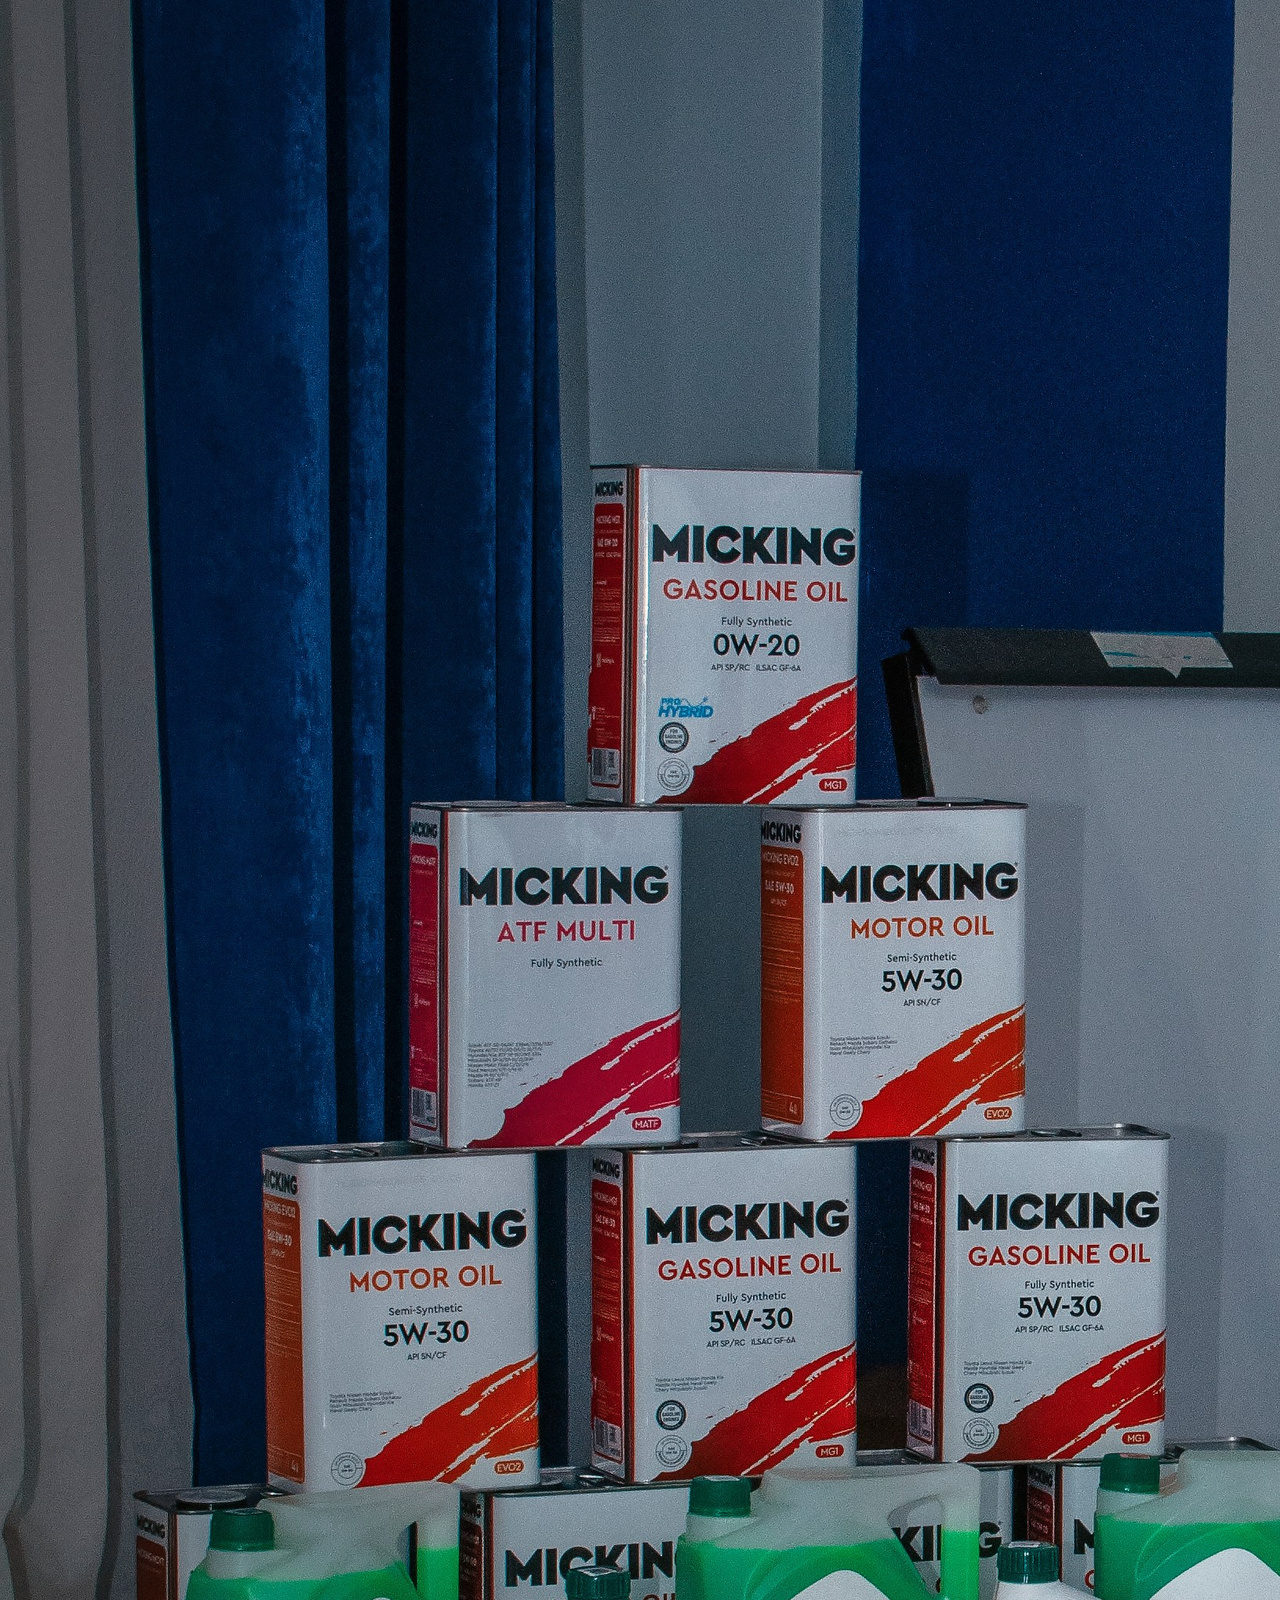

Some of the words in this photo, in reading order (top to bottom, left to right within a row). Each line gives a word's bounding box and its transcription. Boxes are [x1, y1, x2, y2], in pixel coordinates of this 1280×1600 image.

[652, 524, 856, 566] MICKING
[663, 578, 797, 601] GASOLINE
[806, 581, 848, 602] OIL
[721, 616, 744, 628] Fully
[746, 616, 792, 628] Synthetic
[713, 633, 800, 656] 0W-20
[725, 664, 750, 672] SP/RC
[756, 664, 777, 672] ILSAC
[661, 697, 682, 705] PRO
[658, 705, 714, 718] HYBRID
[824, 781, 842, 790] MG1
[459, 865, 669, 906] MICKING
[821, 862, 1018, 903] MICKING
[497, 920, 547, 942] ATF
[556, 920, 636, 941] MULTI
[851, 917, 944, 939] MOTOR
[953, 915, 994, 936] OIL
[531, 958, 553, 969] Fully
[556, 958, 602, 968] Synthetic
[887, 952, 957, 964] Semi-Synthetic
[881, 968, 962, 992] 5W-30
[917, 998, 941, 1006] SN/CF
[986, 1109, 1010, 1118] EVO2
[635, 1119, 659, 1128] MATF
[957, 1191, 1160, 1231] MICKING
[646, 1200, 849, 1245] MICKING
[318, 1209, 527, 1257] MICKING
[968, 1244, 1100, 1266] GASOLINE
[1109, 1243, 1150, 1263] OIL
[658, 1255, 791, 1280] GASOLINE
[800, 1253, 841, 1274] OIL
[350, 1268, 448, 1292] MOTOR
[458, 1264, 502, 1287] OIL
[1025, 1280, 1046, 1291] Fully
[1050, 1279, 1094, 1290] Synthetic
[716, 1293, 738, 1304] Fully
[741, 1291, 786, 1303] Synthetic
[388, 1303, 463, 1316] Semi-Synthetic
[1017, 1295, 1101, 1318] 5W-30
[709, 1307, 793, 1333] 5W-30
[1015, 1325, 1027, 1333] API
[1029, 1325, 1053, 1333] SP/RC
[1059, 1324, 1080, 1332] ILSAC
[384, 1320, 470, 1347] 5W-30
[720, 1339, 745, 1348] SP/RC
[1127, 1433, 1145, 1442] MG1
[821, 1447, 838, 1456] MG1
[496, 1462, 521, 1472] EVO2
[505, 1541, 675, 1587] MICKIN
